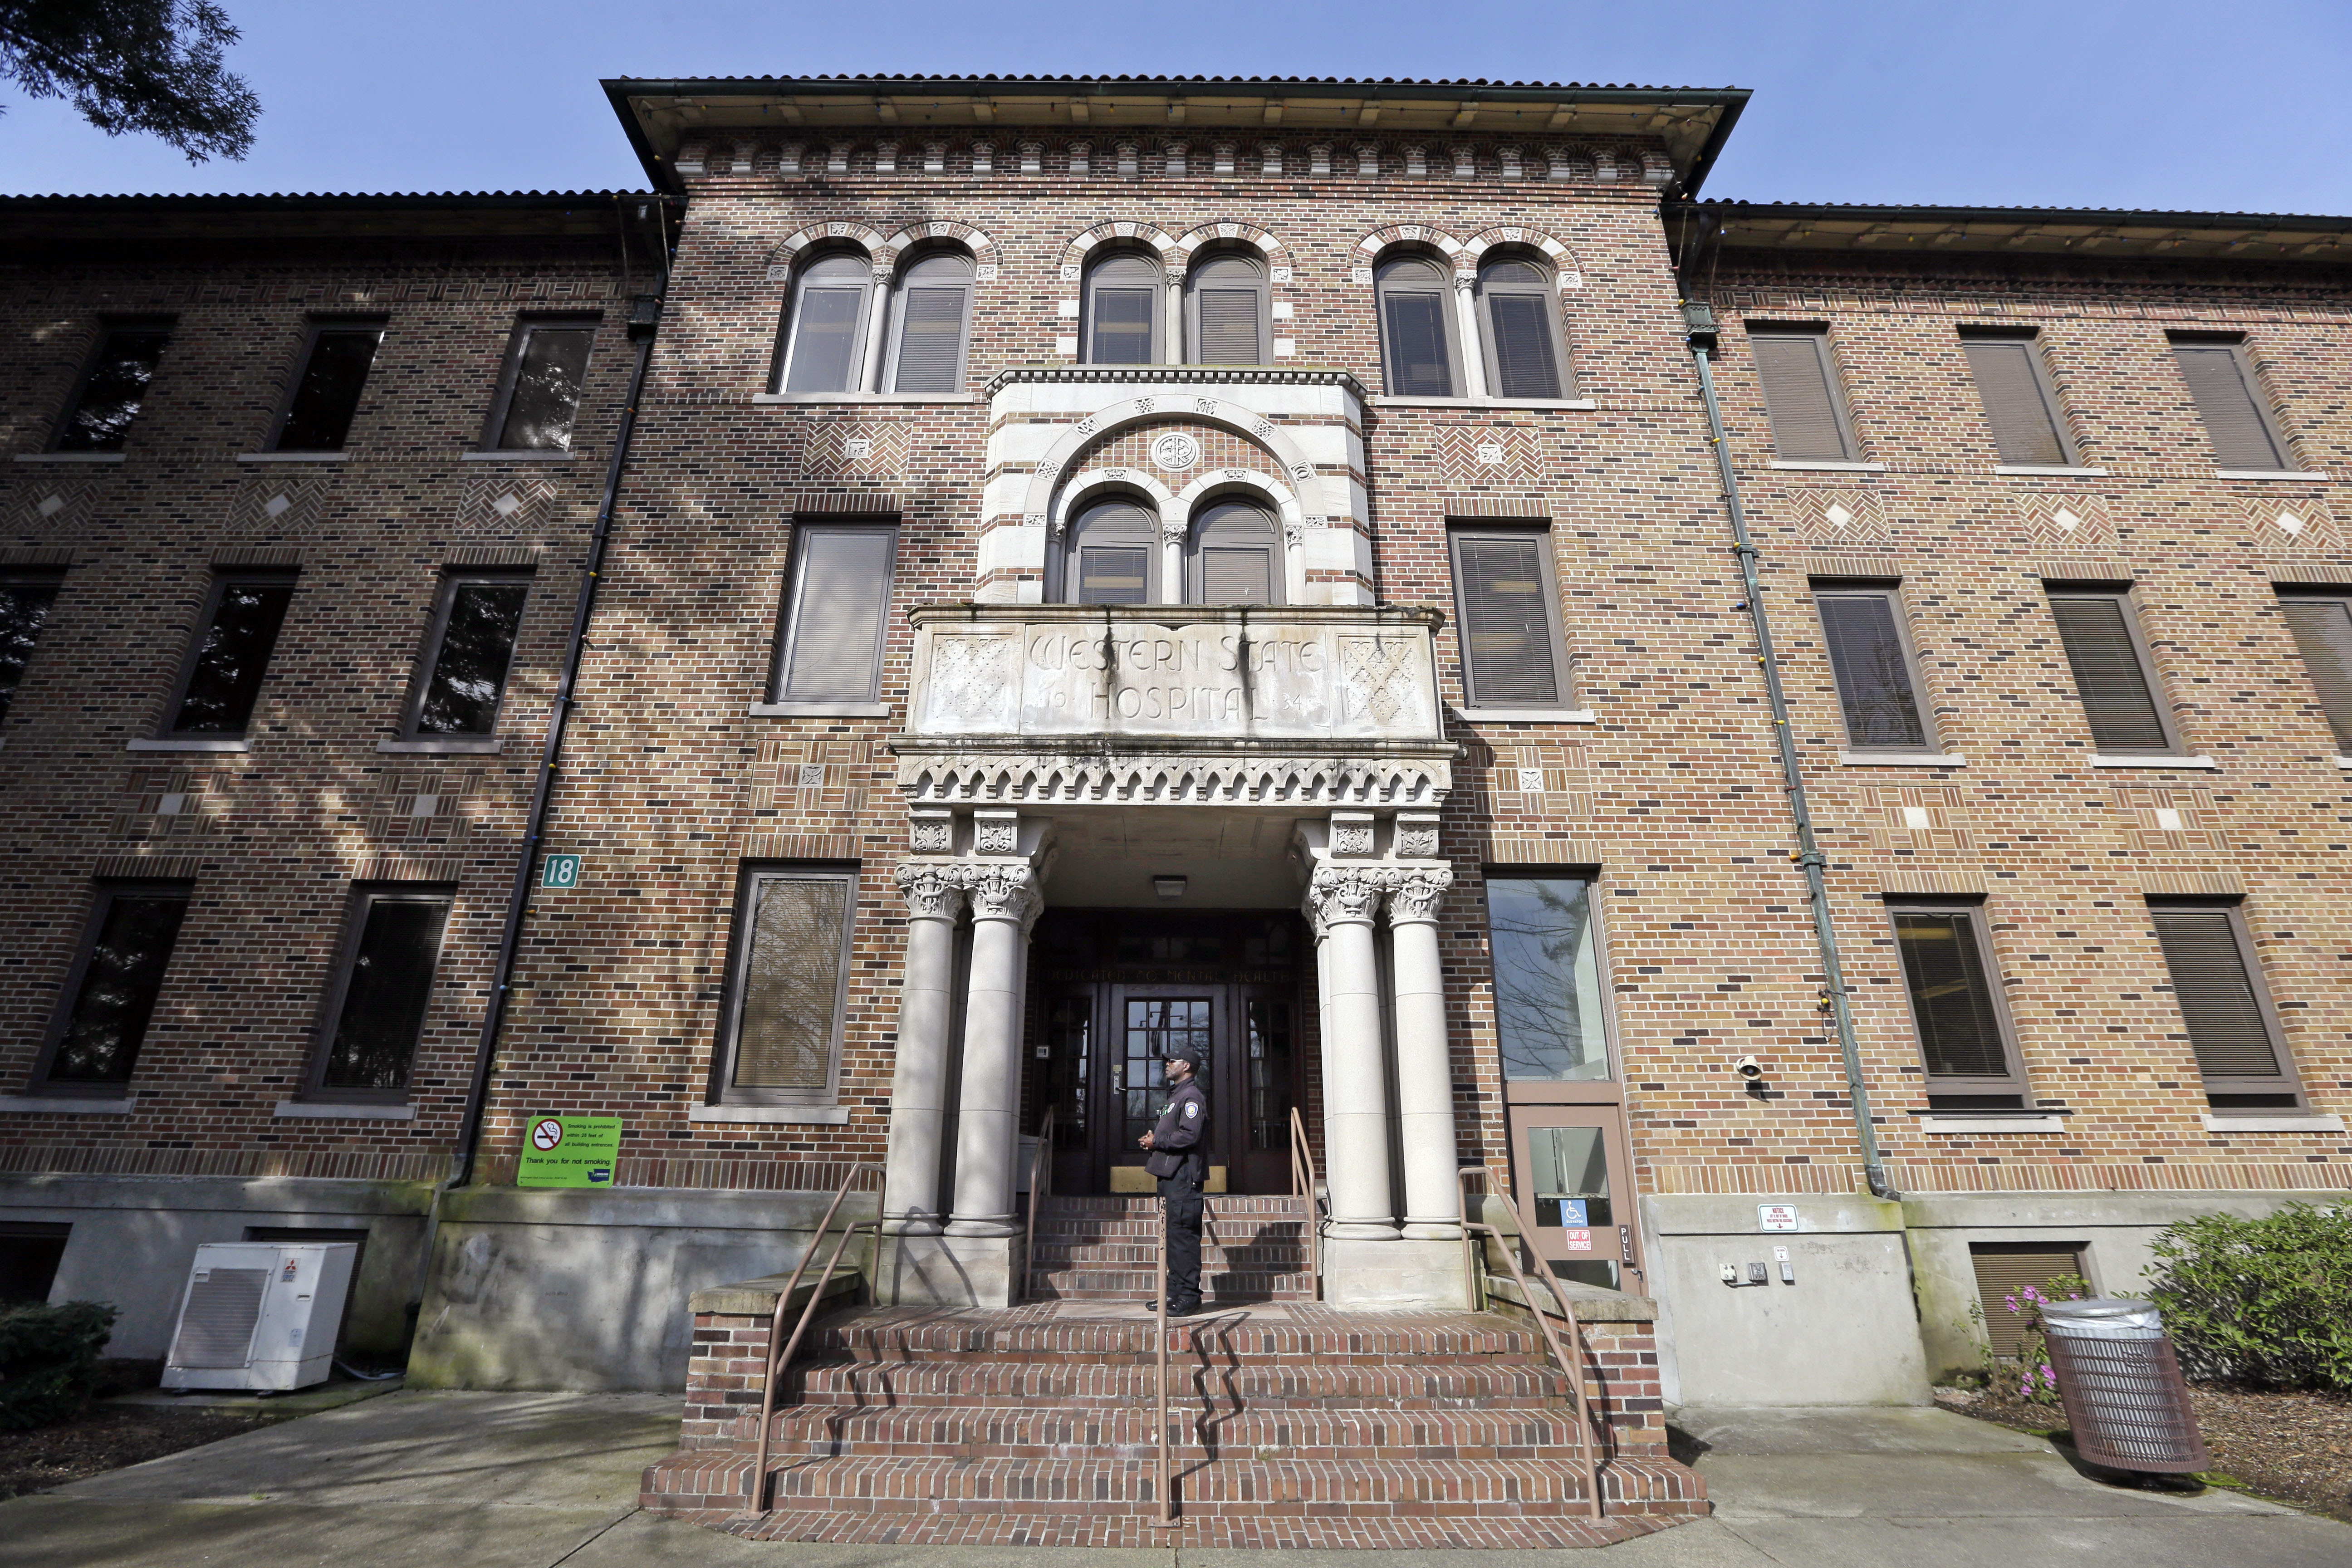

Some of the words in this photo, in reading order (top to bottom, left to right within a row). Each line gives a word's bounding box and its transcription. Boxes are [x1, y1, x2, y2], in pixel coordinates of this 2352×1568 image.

[1029, 635, 1200, 671] WESTERN
[1218, 635, 1322, 672] STATE
[1090, 682, 1269, 720] HOSPITAL
[549, 859, 573, 883] 18
[1047, 969, 1125, 981] DEDICATED
[1166, 970, 1221, 982] MENTAL
[1233, 970, 1289, 982] HEALTH
[1569, 1231, 1579, 1240] OUT
[1581, 1231, 1588, 1240] OF
[1569, 1241, 1590, 1249] SERVICE
[1621, 1227, 1630, 1260] PULL
